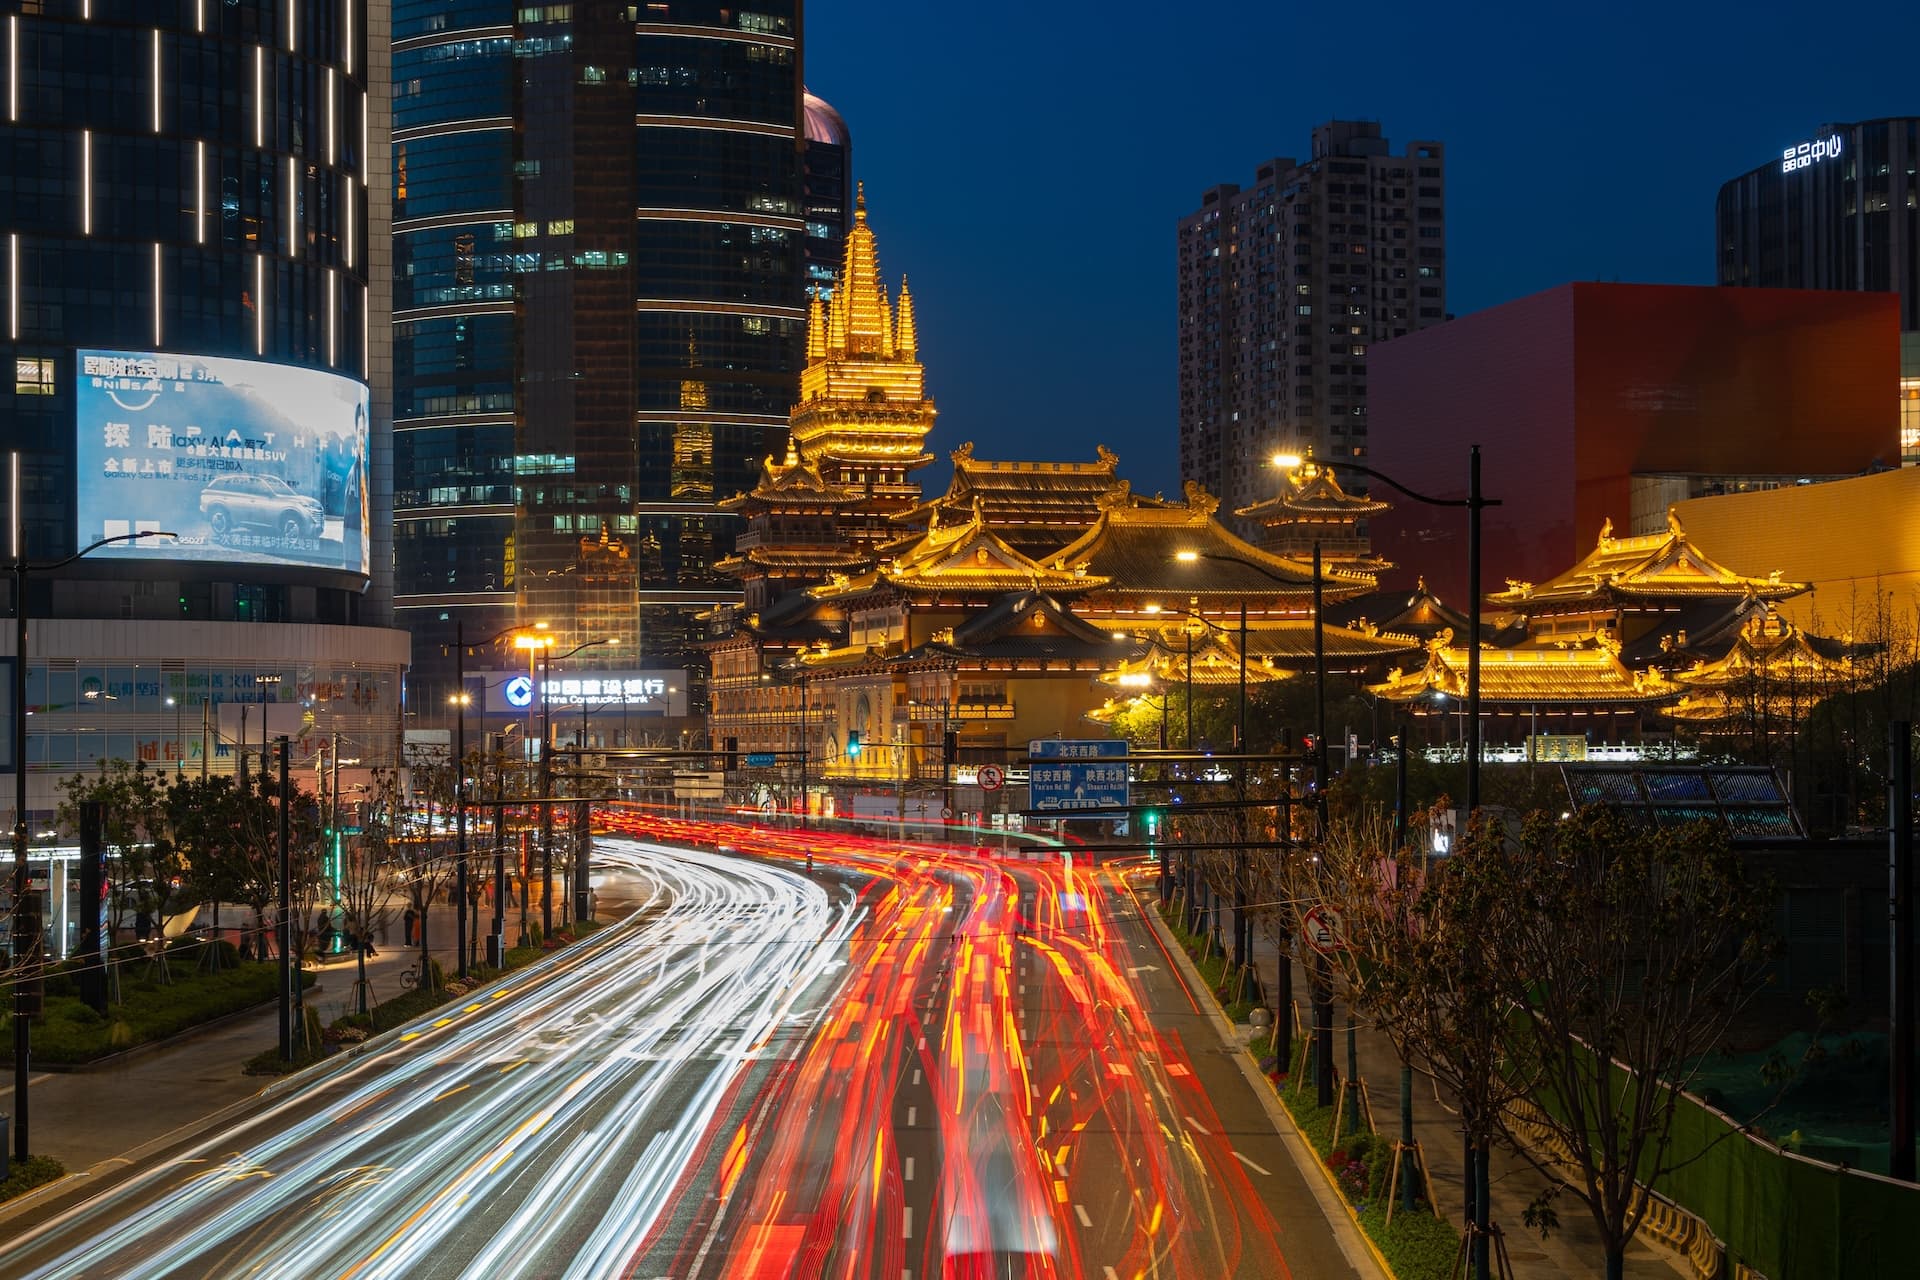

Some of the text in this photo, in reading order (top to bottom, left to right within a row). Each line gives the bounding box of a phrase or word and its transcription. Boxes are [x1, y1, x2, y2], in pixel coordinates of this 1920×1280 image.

[1782, 134, 1842, 173] 晶品中心
[104, 379, 163, 391] NISAN
[104, 457, 172, 473] 全新上市
[541, 679, 665, 696] 中国建设银行
[1060, 745, 1098, 757] 北京西路
[1033, 769, 1072, 782] 延安西路
[1086, 769, 1125, 782] 陕西北路
